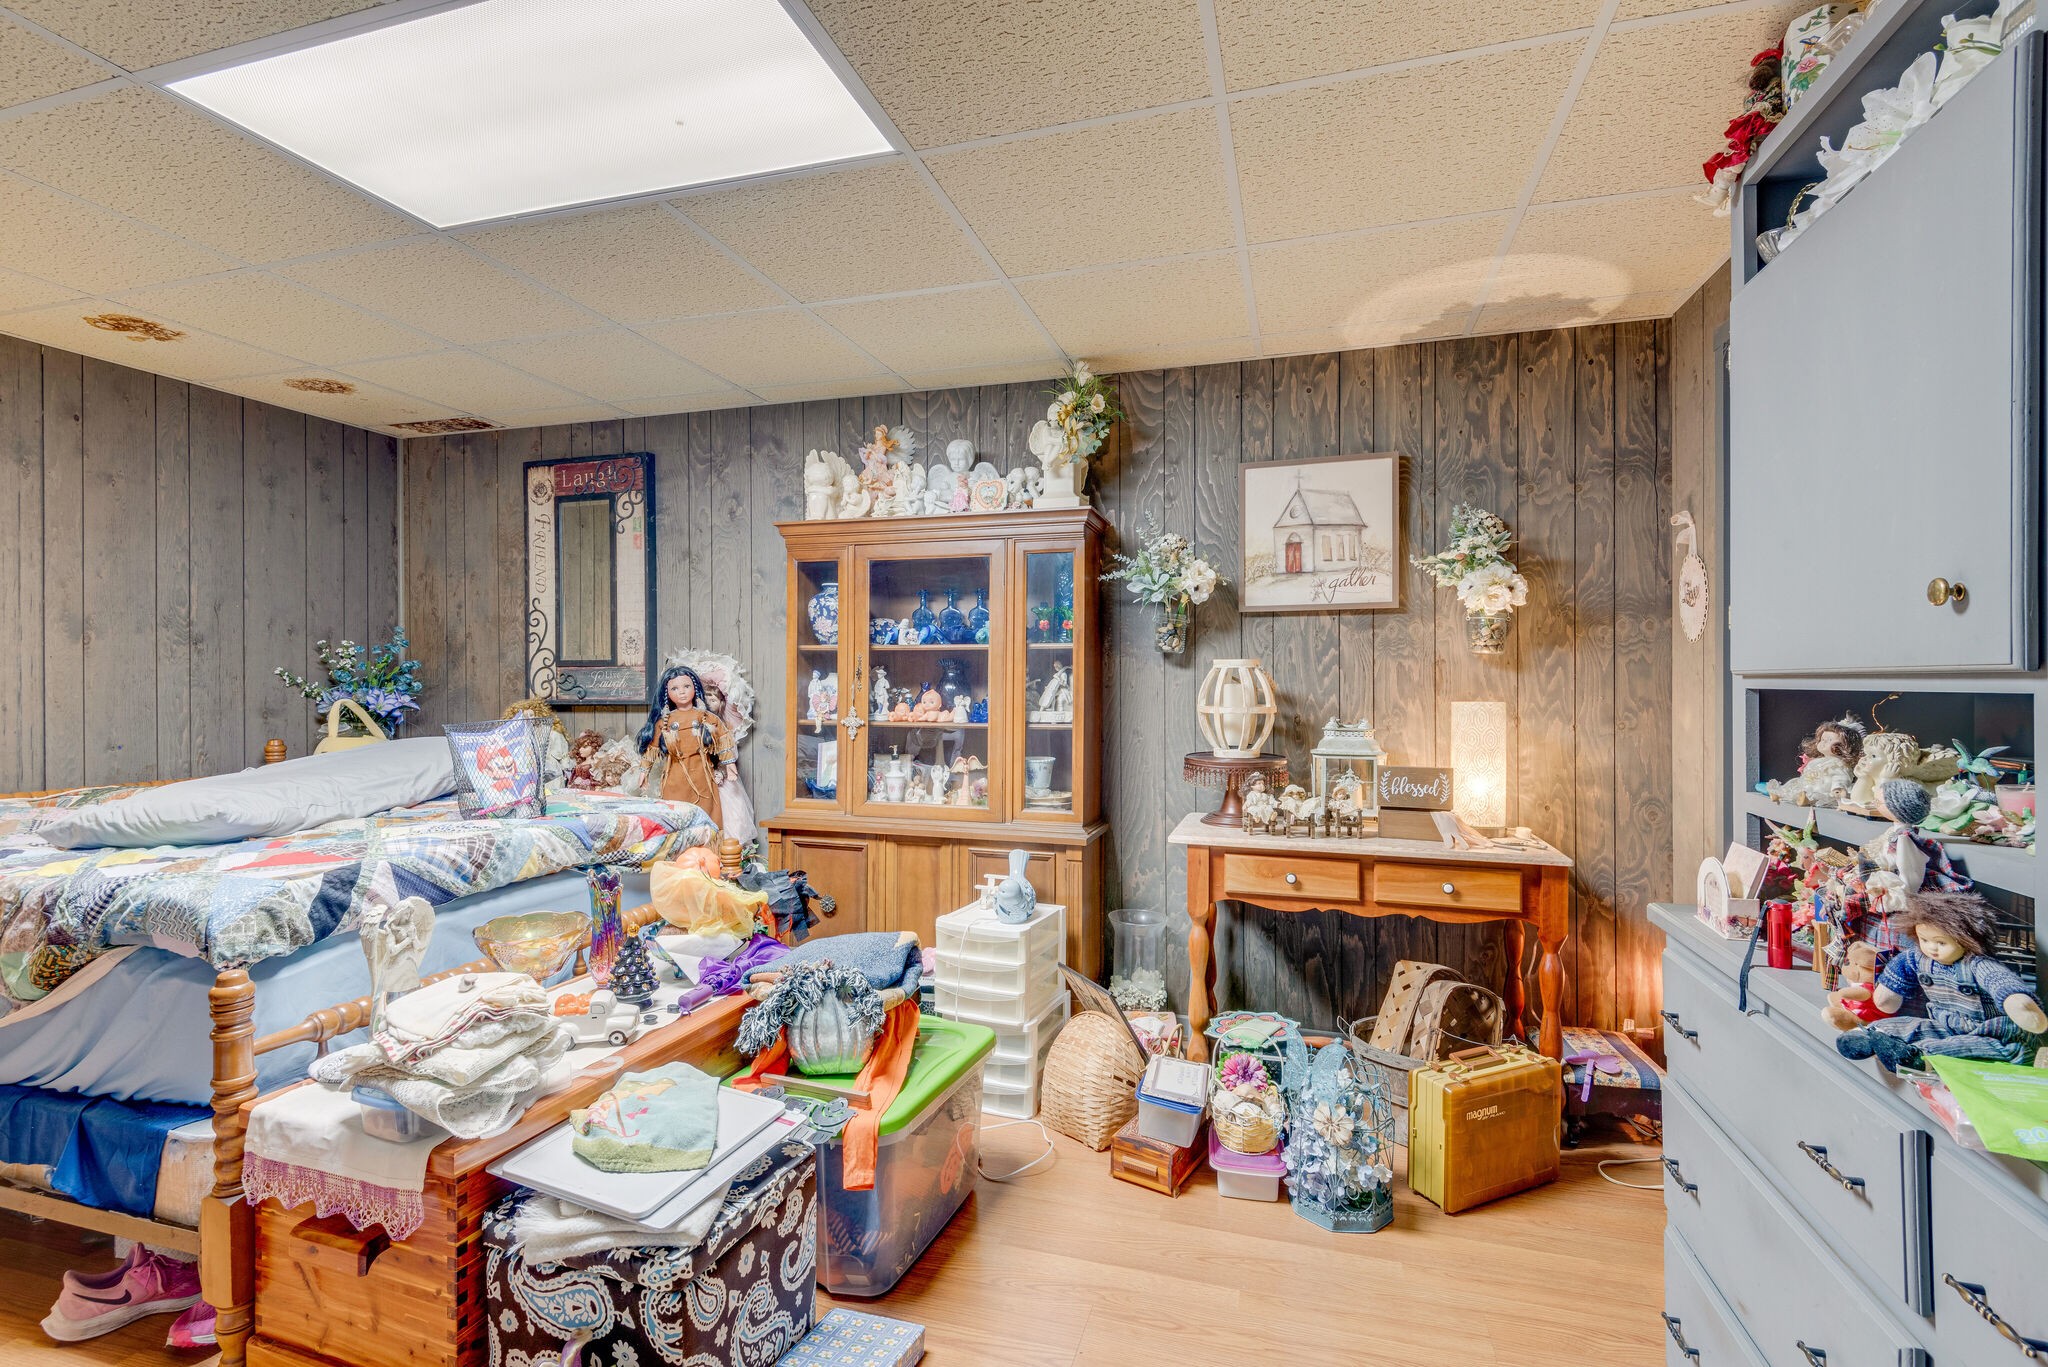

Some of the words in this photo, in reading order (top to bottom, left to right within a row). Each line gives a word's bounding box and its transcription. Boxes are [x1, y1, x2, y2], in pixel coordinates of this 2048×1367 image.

[561, 465, 617, 488] Laugh
[534, 513, 551, 594] FRIEND
[1322, 566, 1377, 603] gather
[589, 670, 631, 689] Laugh
[1390, 776, 1440, 797] blessed
[1466, 1105, 1498, 1121] magnum
